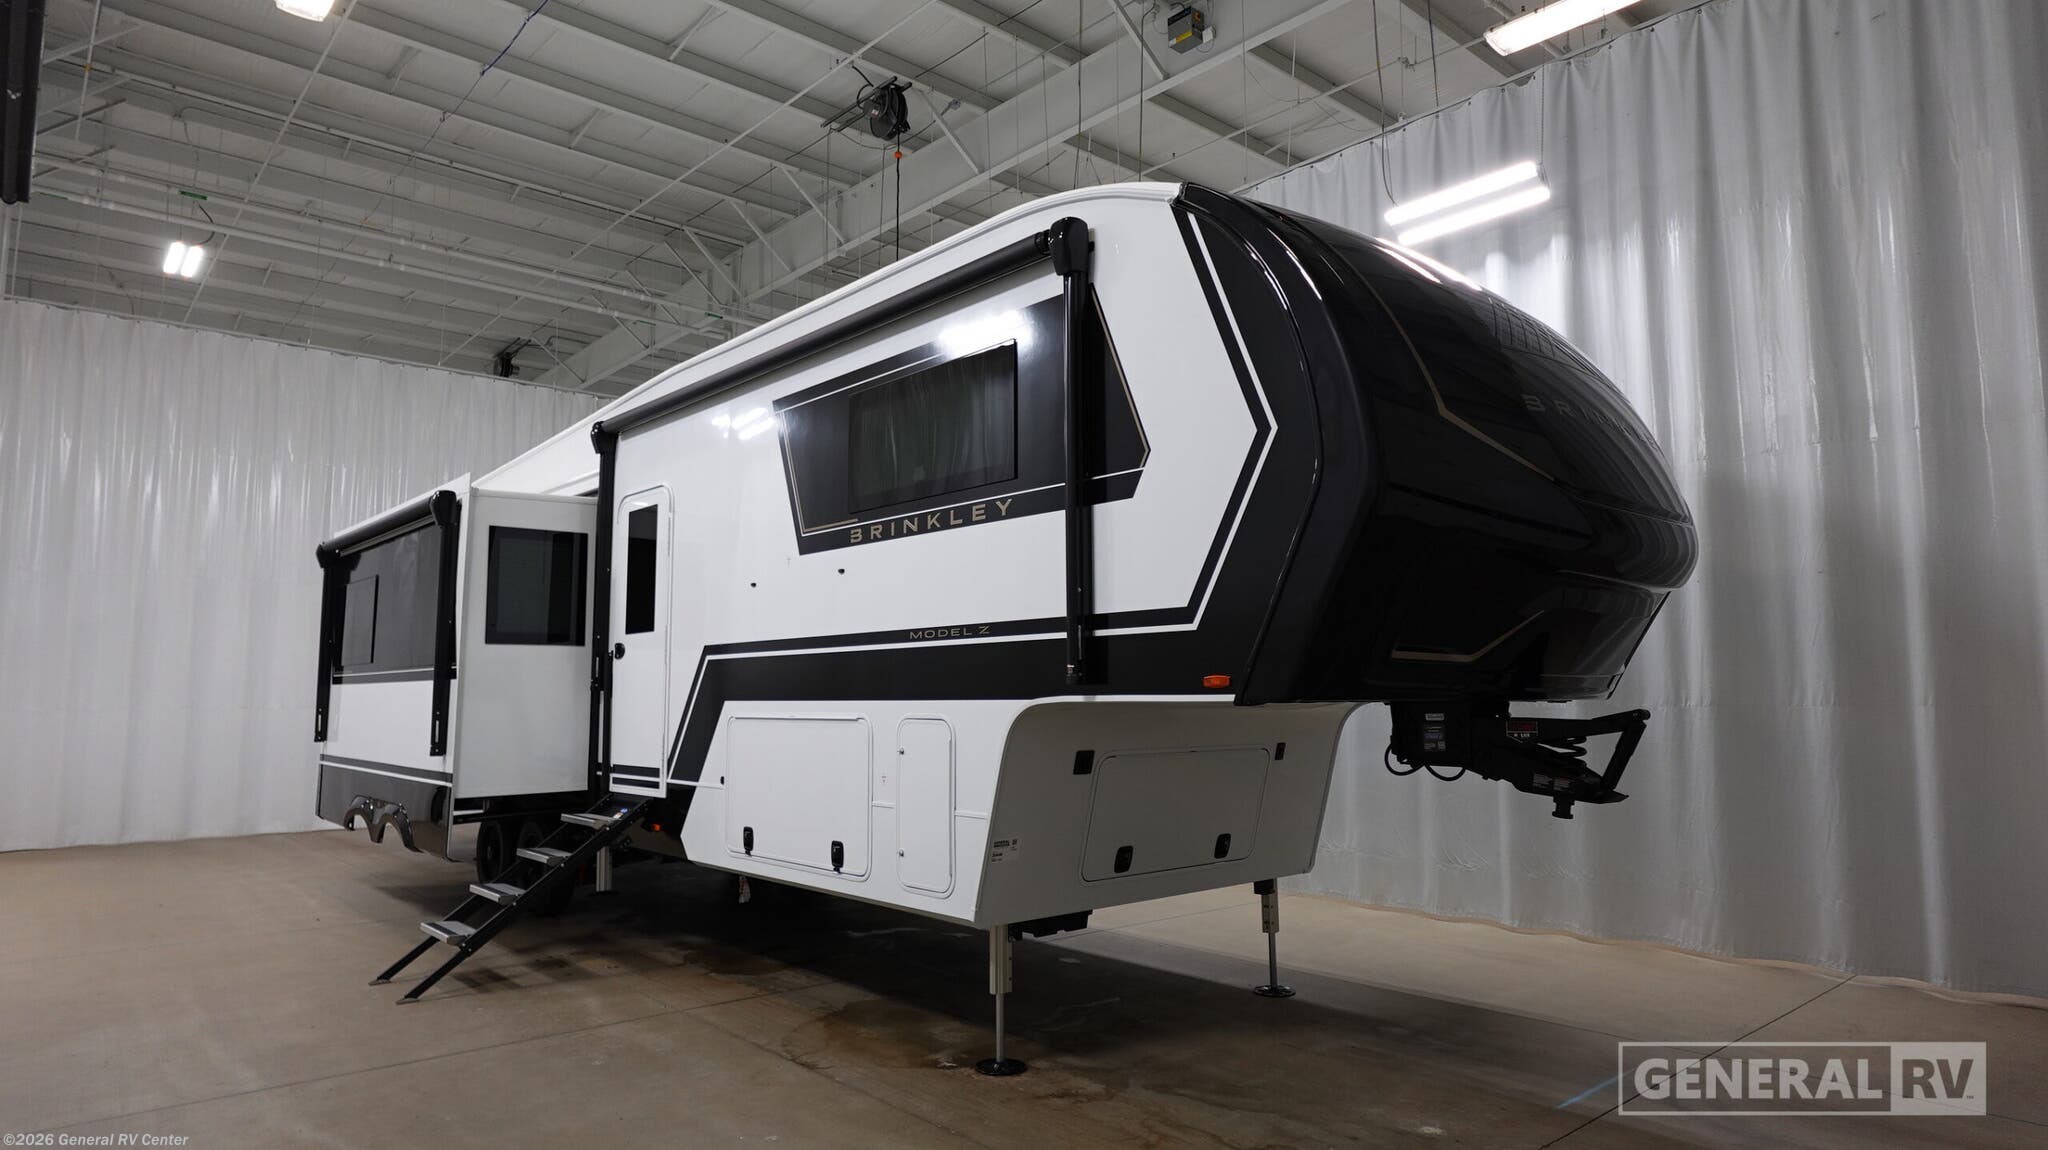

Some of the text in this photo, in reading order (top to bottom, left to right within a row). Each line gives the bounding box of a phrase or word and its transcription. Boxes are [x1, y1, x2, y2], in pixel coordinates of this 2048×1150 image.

[850, 499, 1012, 543] BRINKLEY
[910, 626, 990, 639] MODEL Z
